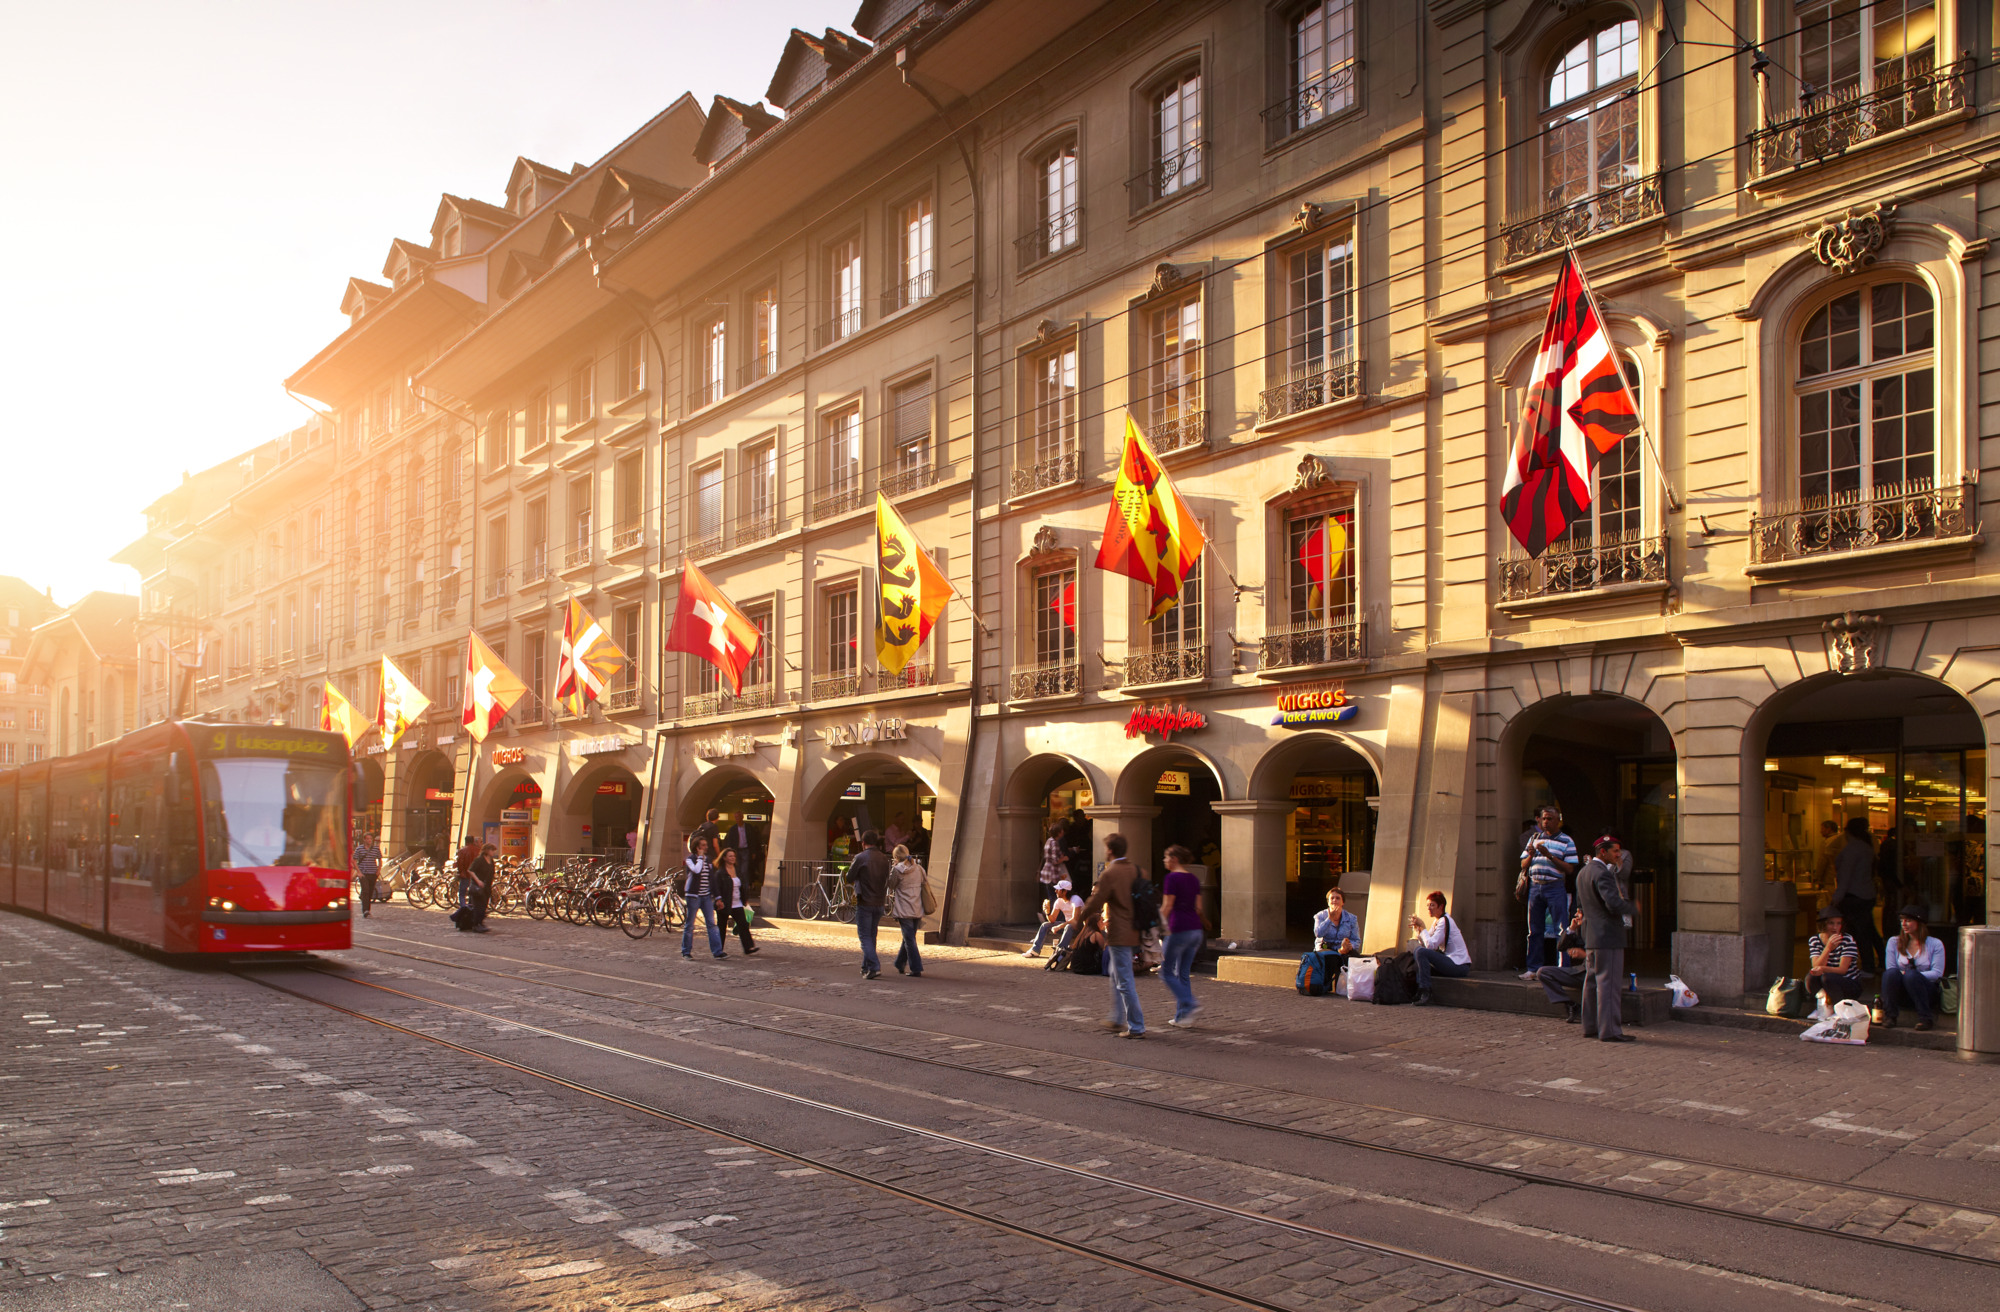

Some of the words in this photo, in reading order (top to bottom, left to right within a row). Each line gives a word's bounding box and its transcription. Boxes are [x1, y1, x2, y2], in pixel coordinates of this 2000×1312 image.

[1277, 688, 1348, 712] MIGROS
[1123, 703, 1207, 741] Hotelplan
[1282, 711, 1307, 723] Take
[1309, 709, 1341, 721] Away
[367, 743, 385, 755] zebra
[492, 747, 525, 765] MIGROS
